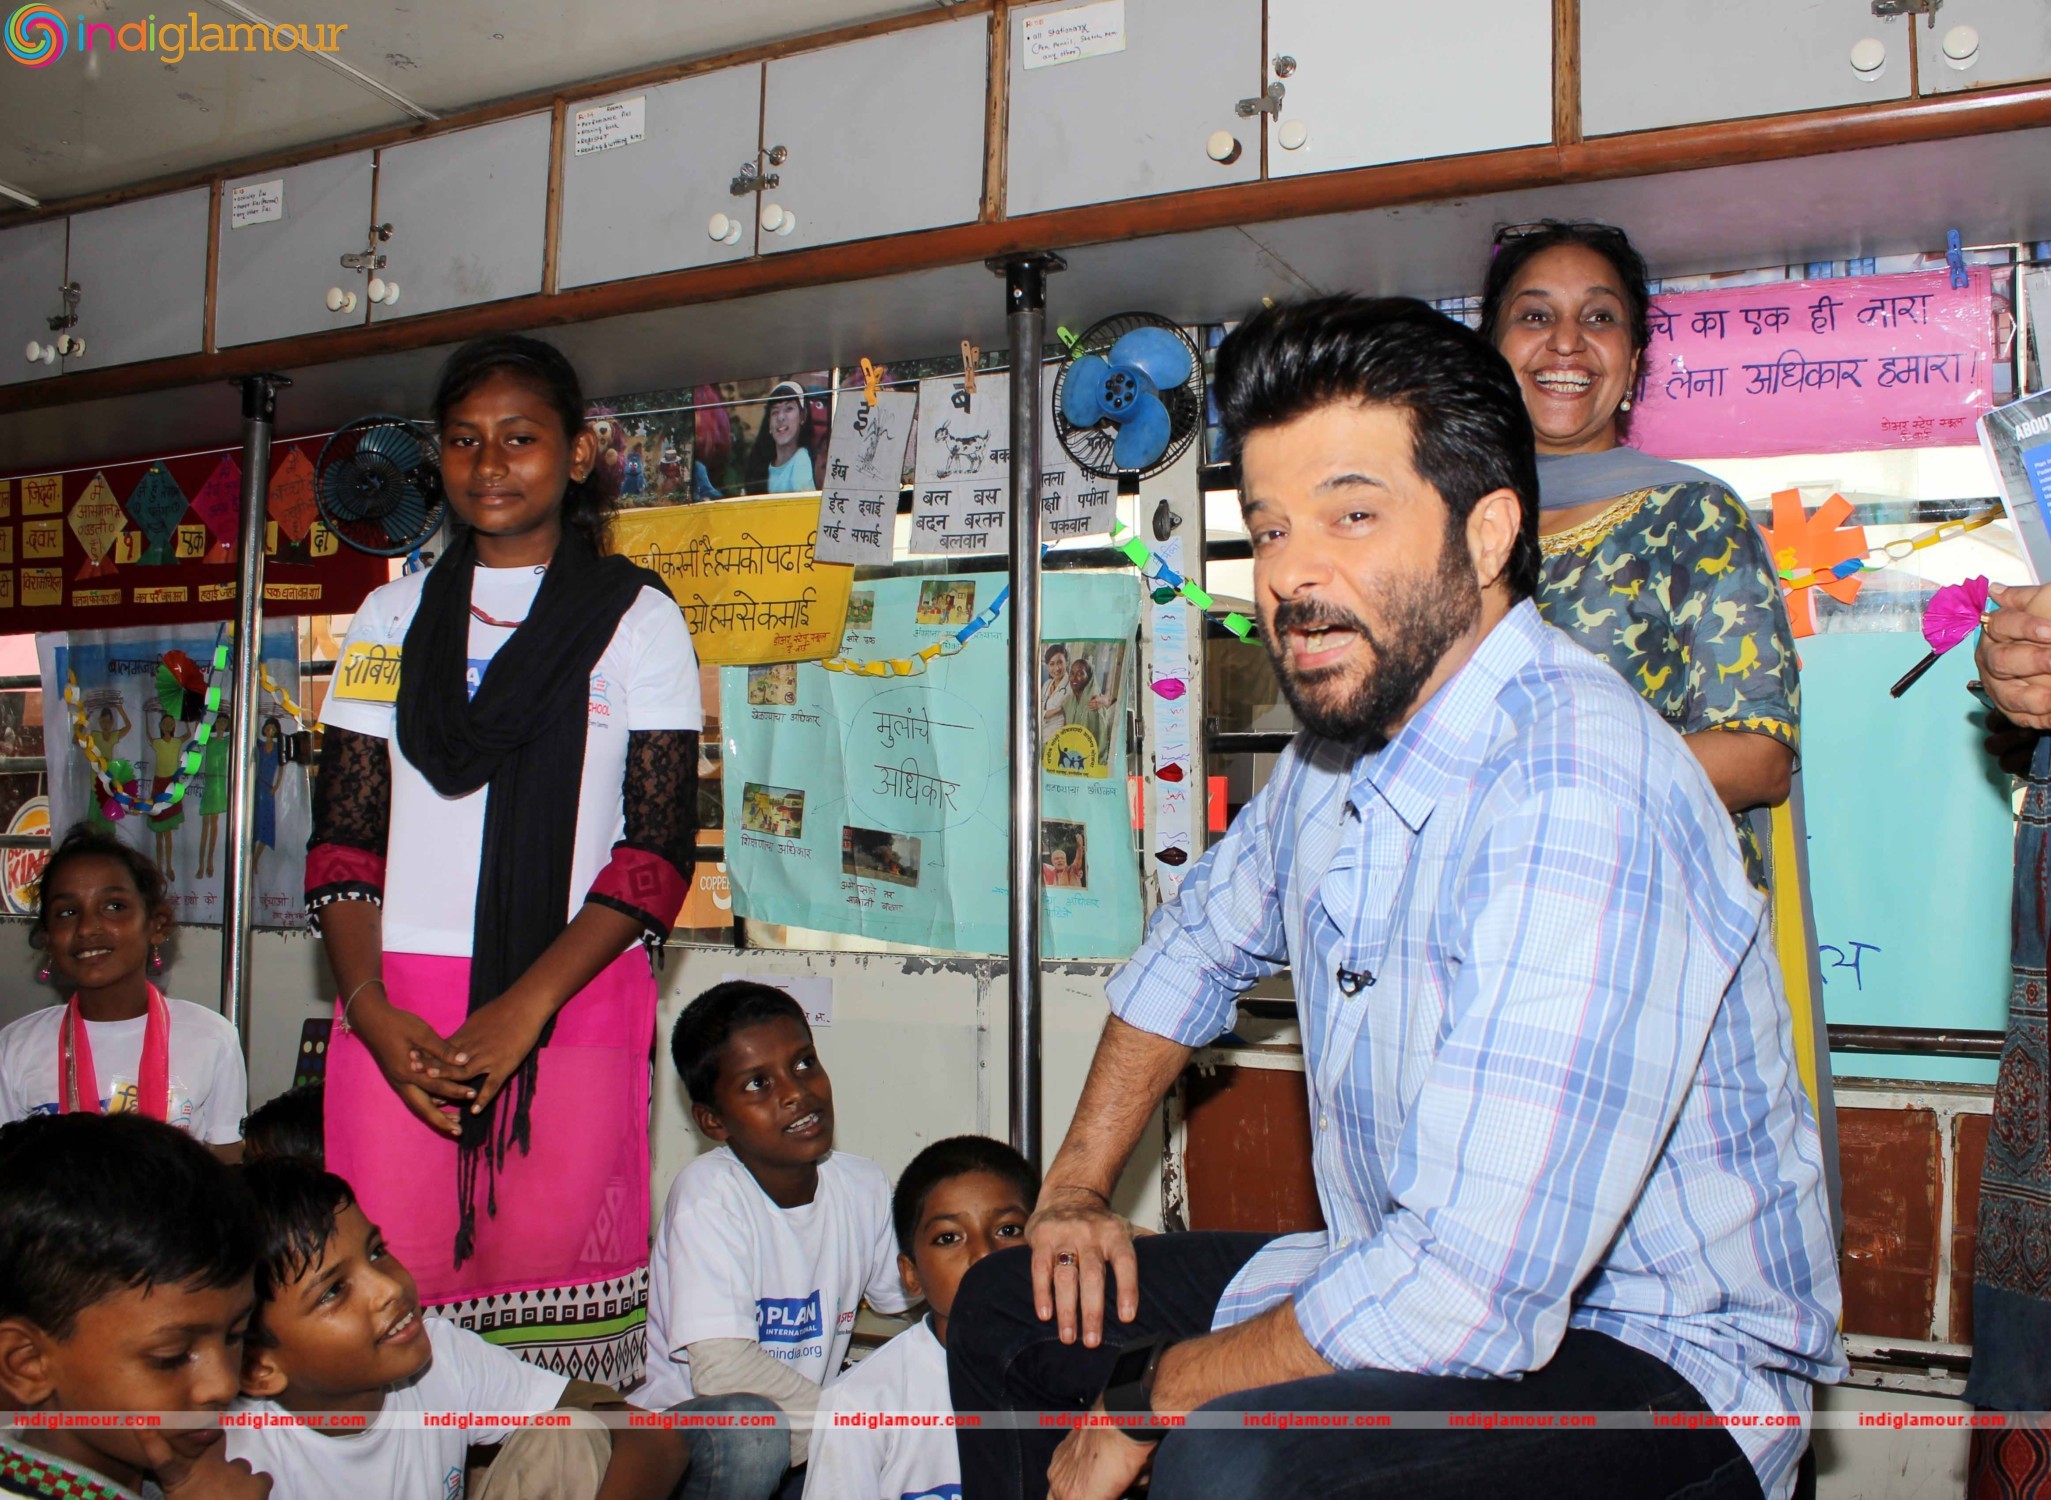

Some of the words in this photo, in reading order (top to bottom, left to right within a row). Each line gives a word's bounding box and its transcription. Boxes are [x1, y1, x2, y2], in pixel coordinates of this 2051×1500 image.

[1691, 310, 1731, 340] का
[1739, 307, 1790, 336] एक
[1808, 295, 1844, 335] ही
[1856, 293, 1935, 329] नारा
[1741, 349, 1869, 396] अधिकार
[831, 458, 850, 482] ईख
[1042, 471, 1066, 487] तला
[828, 491, 850, 515] ईद
[858, 494, 886, 518] दवाई
[922, 490, 953, 507] बल
[973, 488, 1002, 506] बस
[1042, 491, 1061, 515] क्षी
[1077, 487, 1110, 509] पपीता
[823, 520, 846, 543] राई
[851, 523, 883, 548] सफाई
[915, 514, 950, 532] बदन
[964, 511, 1006, 529] बरतन
[1049, 516, 1092, 535] पकवान
[939, 532, 989, 550] बलवान
[872, 757, 961, 812] अधिकार
[766, 1301, 817, 1326] PLAN
